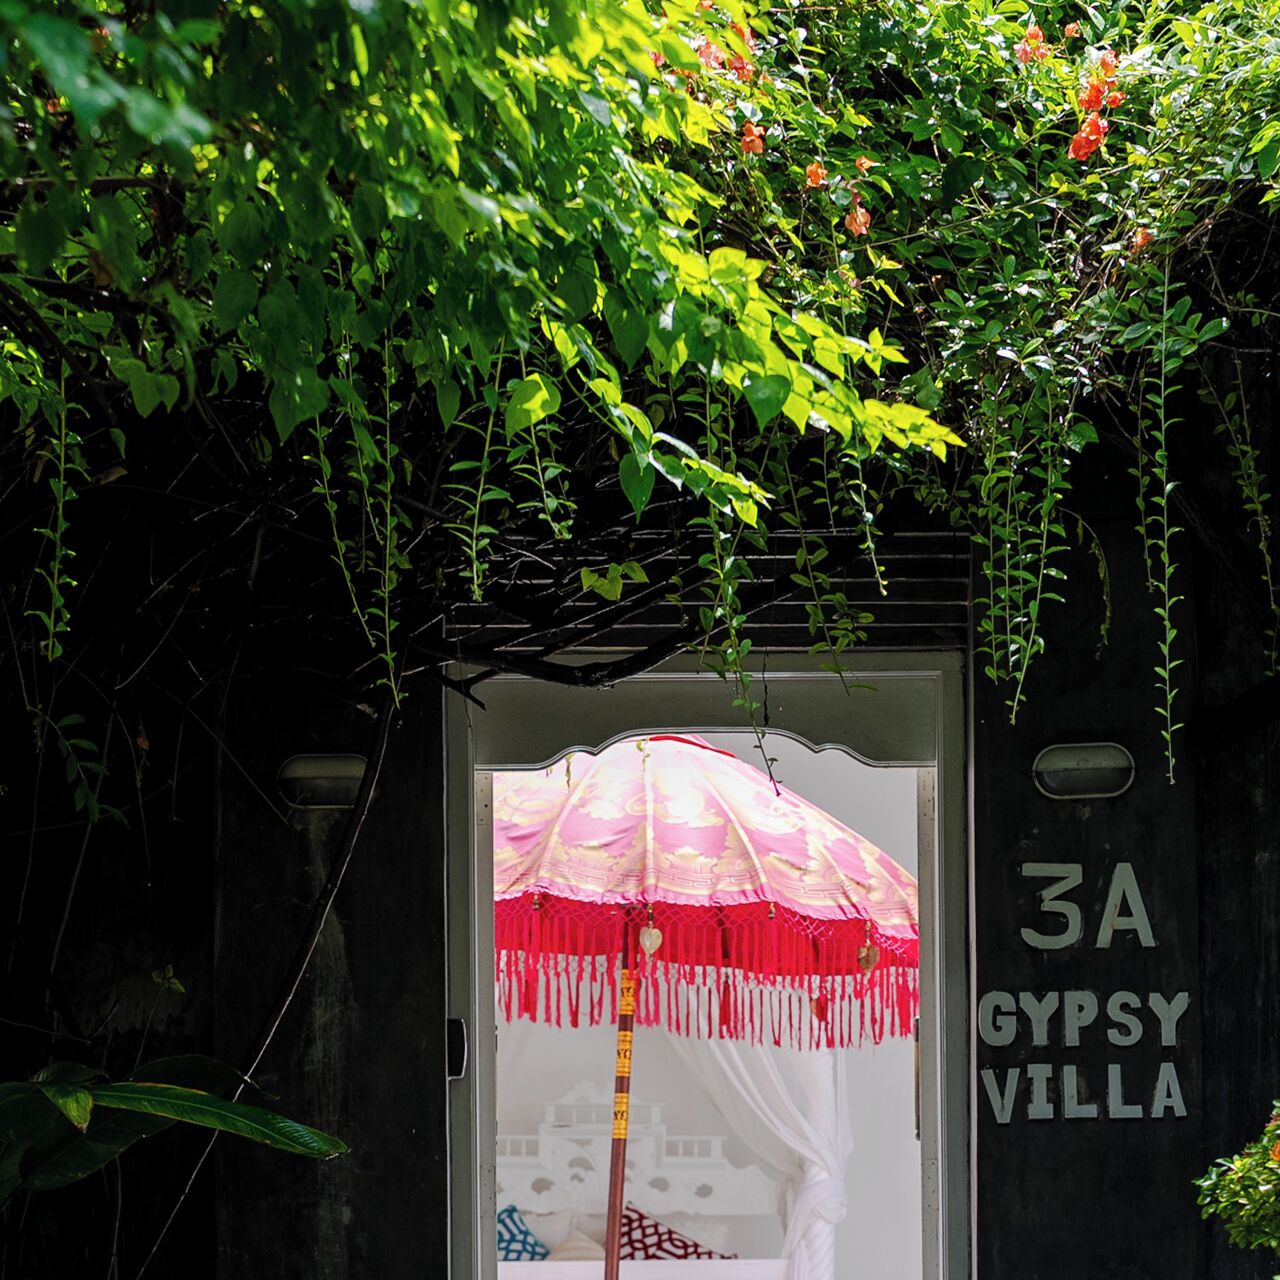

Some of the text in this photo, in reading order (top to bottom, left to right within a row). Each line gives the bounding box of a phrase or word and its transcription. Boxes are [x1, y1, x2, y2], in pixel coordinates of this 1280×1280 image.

[1021, 862, 1157, 949] 3A
[978, 990, 1190, 1048] GYPSY
[981, 1062, 1187, 1124] VILLA
